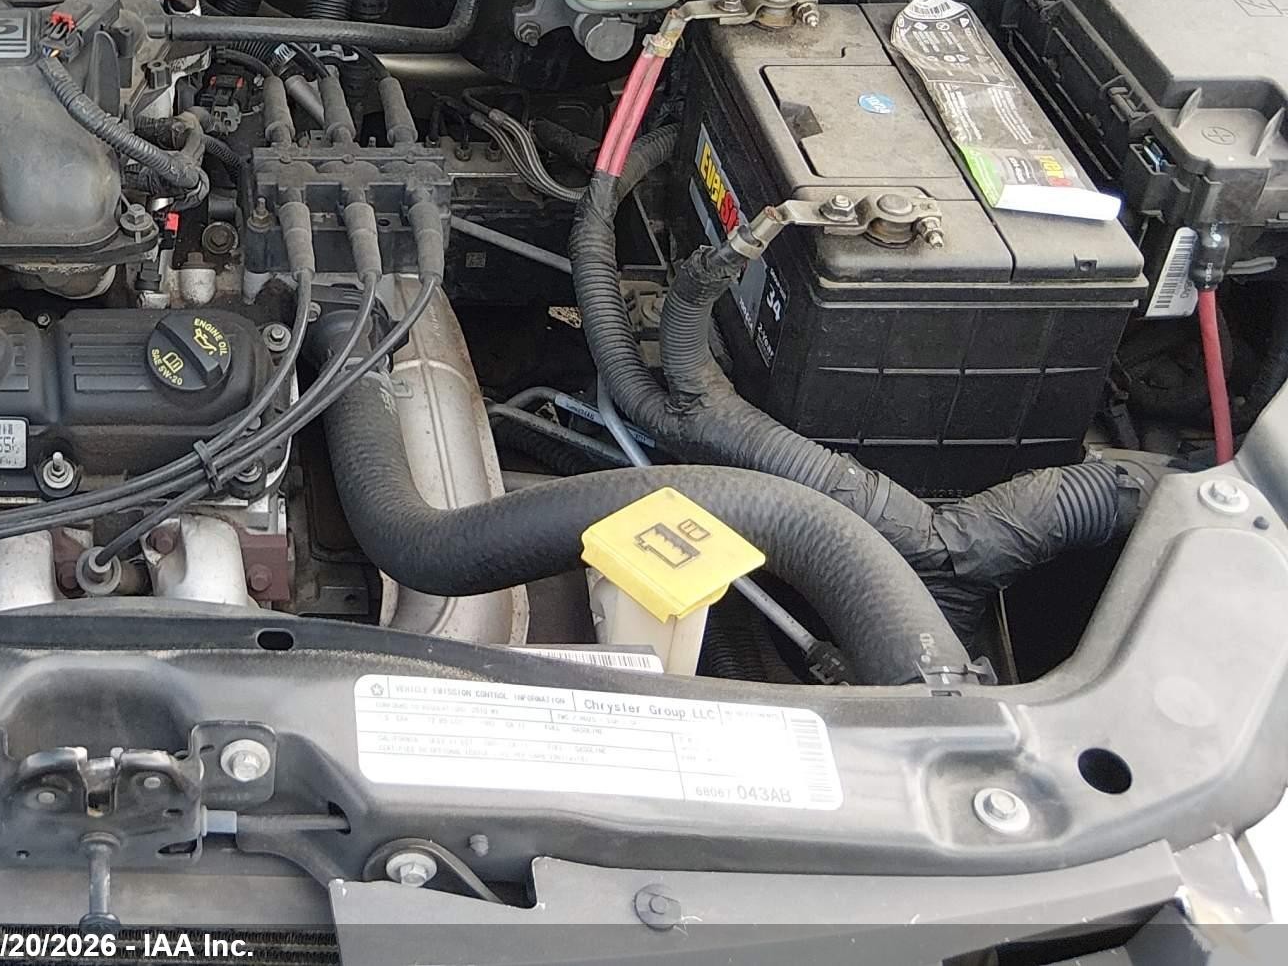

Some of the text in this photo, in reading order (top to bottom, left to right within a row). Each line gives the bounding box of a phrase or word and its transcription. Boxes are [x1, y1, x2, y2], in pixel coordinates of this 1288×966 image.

[700, 141, 741, 235] EverSt
[765, 289, 782, 321] 34
[194, 318, 229, 356] ENGINE OIL
[152, 348, 162, 364] SAE
[432, 687, 472, 698] EMISSION
[475, 689, 509, 701] CONTROL
[648, 703, 687, 721] Group
[692, 706, 717, 720] LLC
[736, 784, 792, 804] 043AB
